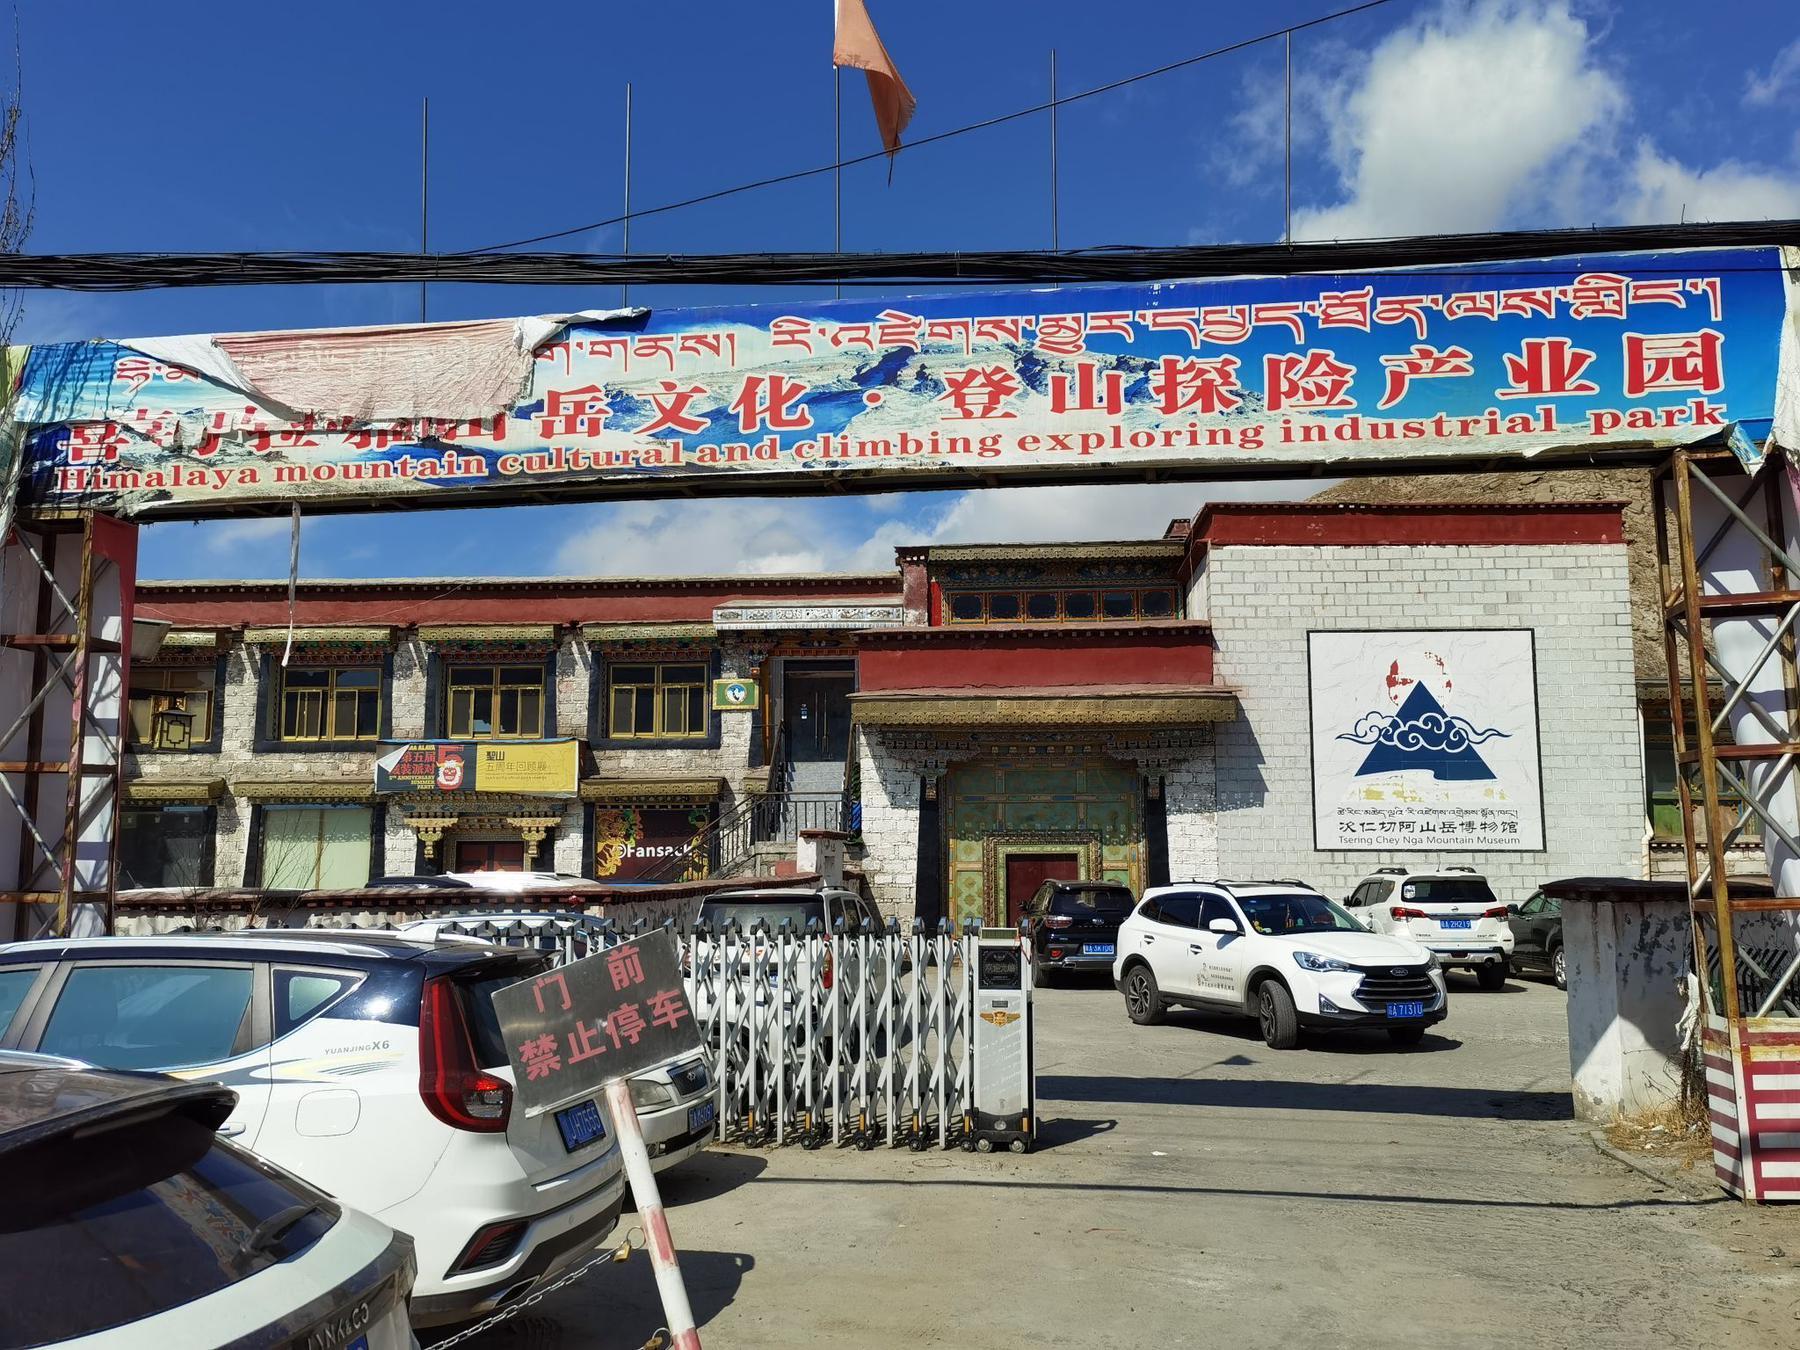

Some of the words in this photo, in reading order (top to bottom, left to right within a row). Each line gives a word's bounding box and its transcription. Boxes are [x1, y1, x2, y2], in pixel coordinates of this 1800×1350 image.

[57, 466, 260, 491] Himalaya
[275, 453, 486, 482] mountain
[499, 441, 682, 472] cultural
[697, 438, 779, 464] and
[795, 431, 1003, 461] climbing
[1017, 421, 1264, 456] exploring
[1281, 406, 1557, 444] industrial
[1591, 400, 1724, 436] park
[1338, 820, 1519, 834] 次仁切阿山岳博物馆
[1339, 835, 1373, 845] Tsering
[1375, 835, 1400, 846] Chey
[1403, 836, 1423, 846] Nga
[1426, 835, 1474, 845] Mountain
[1477, 835, 1521, 845] Museum
[518, 988, 689, 1081] 禁止停车
